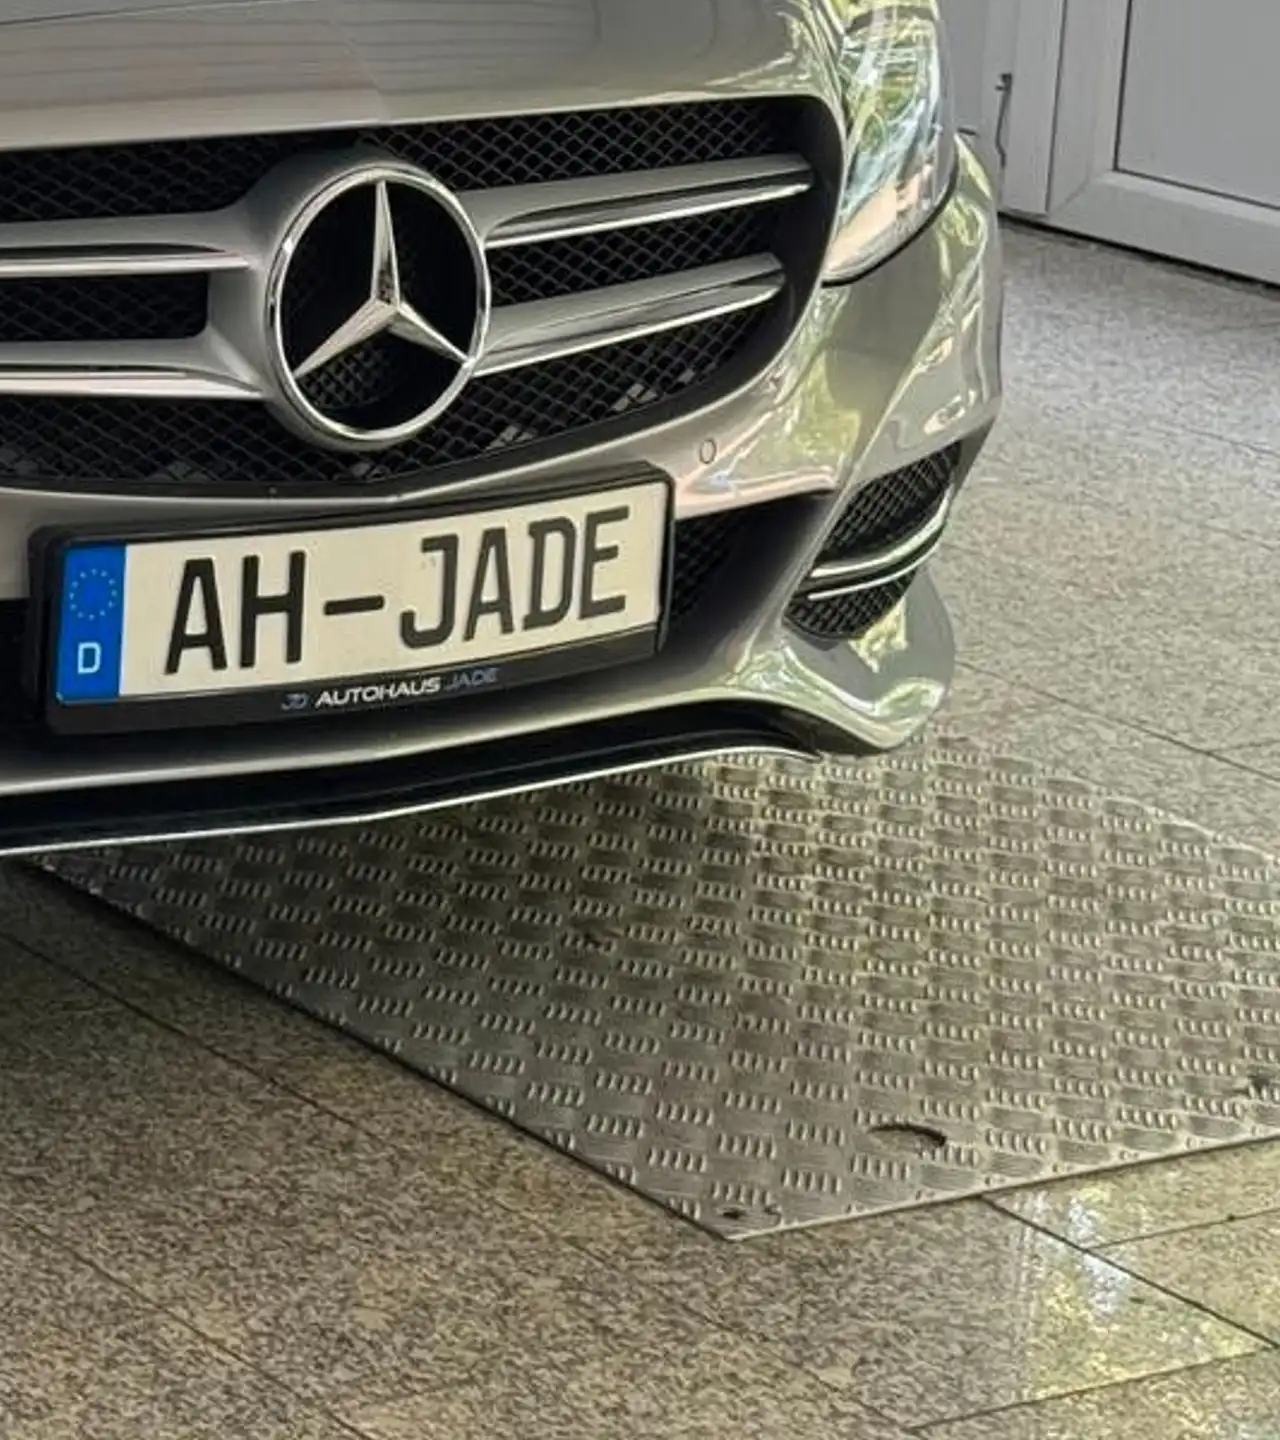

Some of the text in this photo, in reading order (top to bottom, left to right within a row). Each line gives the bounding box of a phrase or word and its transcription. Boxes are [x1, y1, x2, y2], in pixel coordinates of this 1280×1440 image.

[164, 505, 631, 675] AH-JADE
[77, 642, 101, 674] D
[314, 677, 441, 709] AUTOHAUS
[446, 667, 500, 692] JADE
